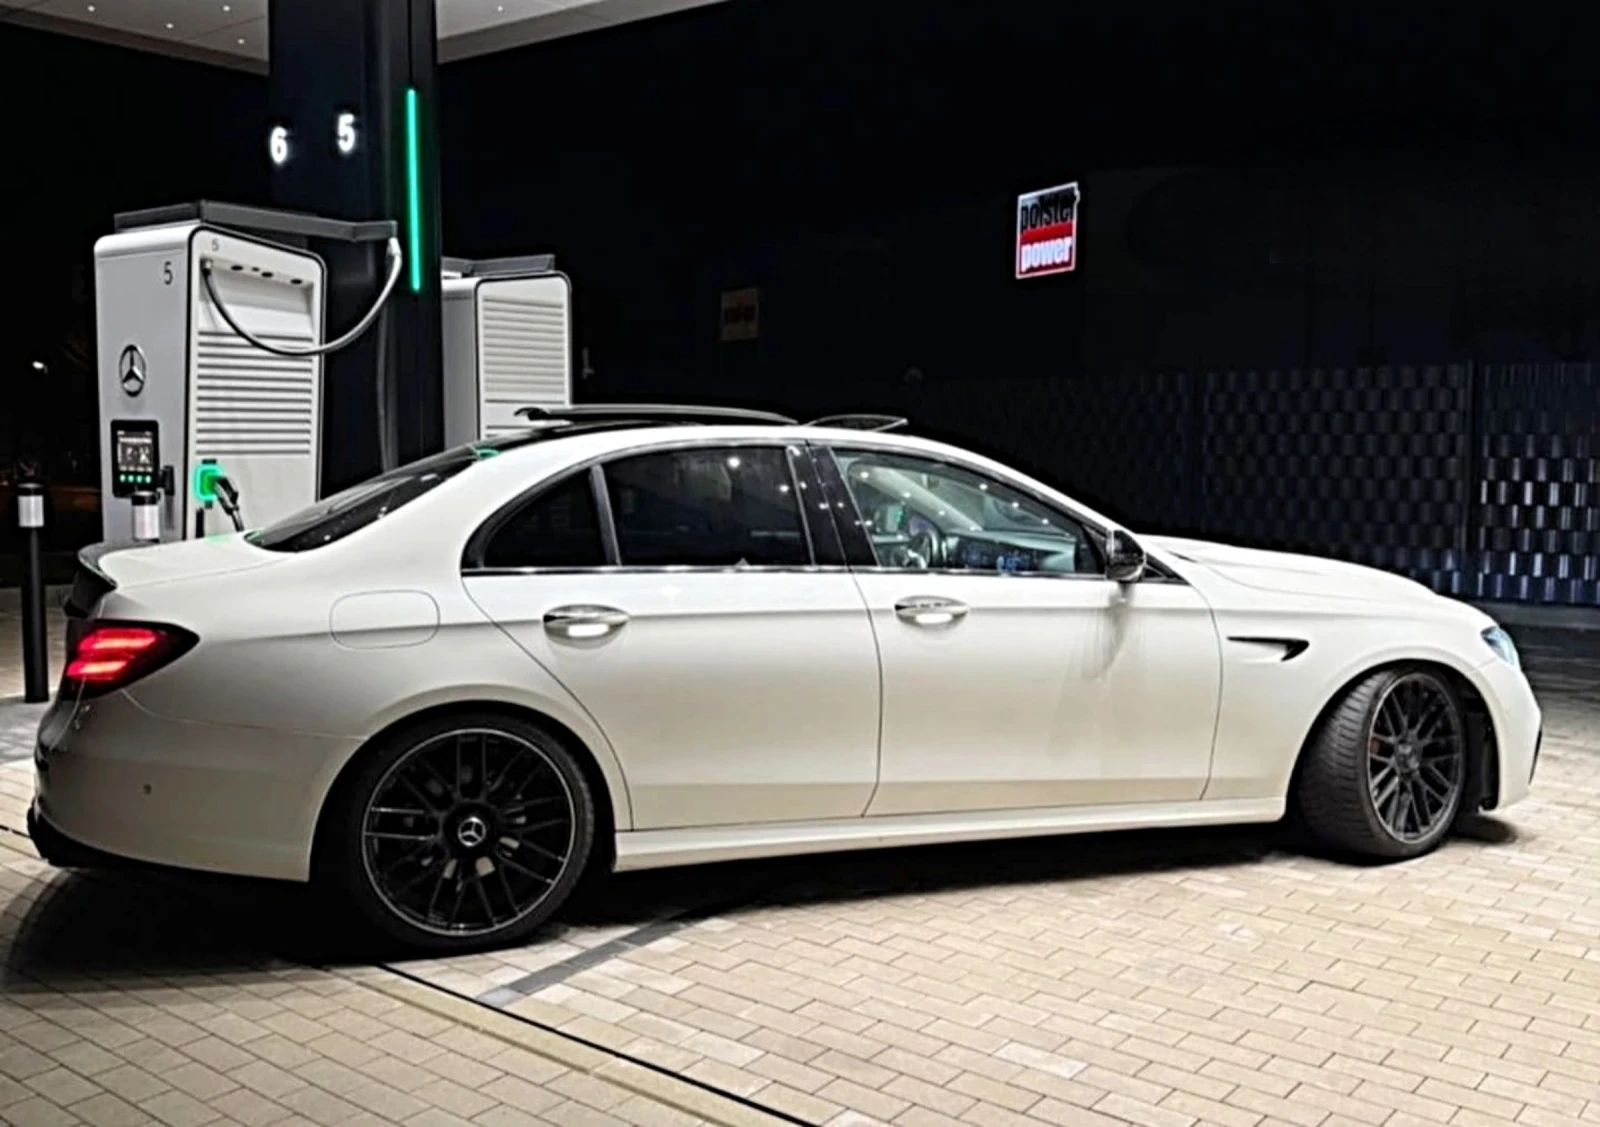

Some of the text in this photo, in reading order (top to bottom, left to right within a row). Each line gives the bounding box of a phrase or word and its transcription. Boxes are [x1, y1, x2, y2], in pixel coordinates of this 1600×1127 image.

[270, 126, 288, 165] 6
[338, 113, 355, 152] 5
[1021, 236, 1072, 272] power
[163, 261, 173, 285] 5
